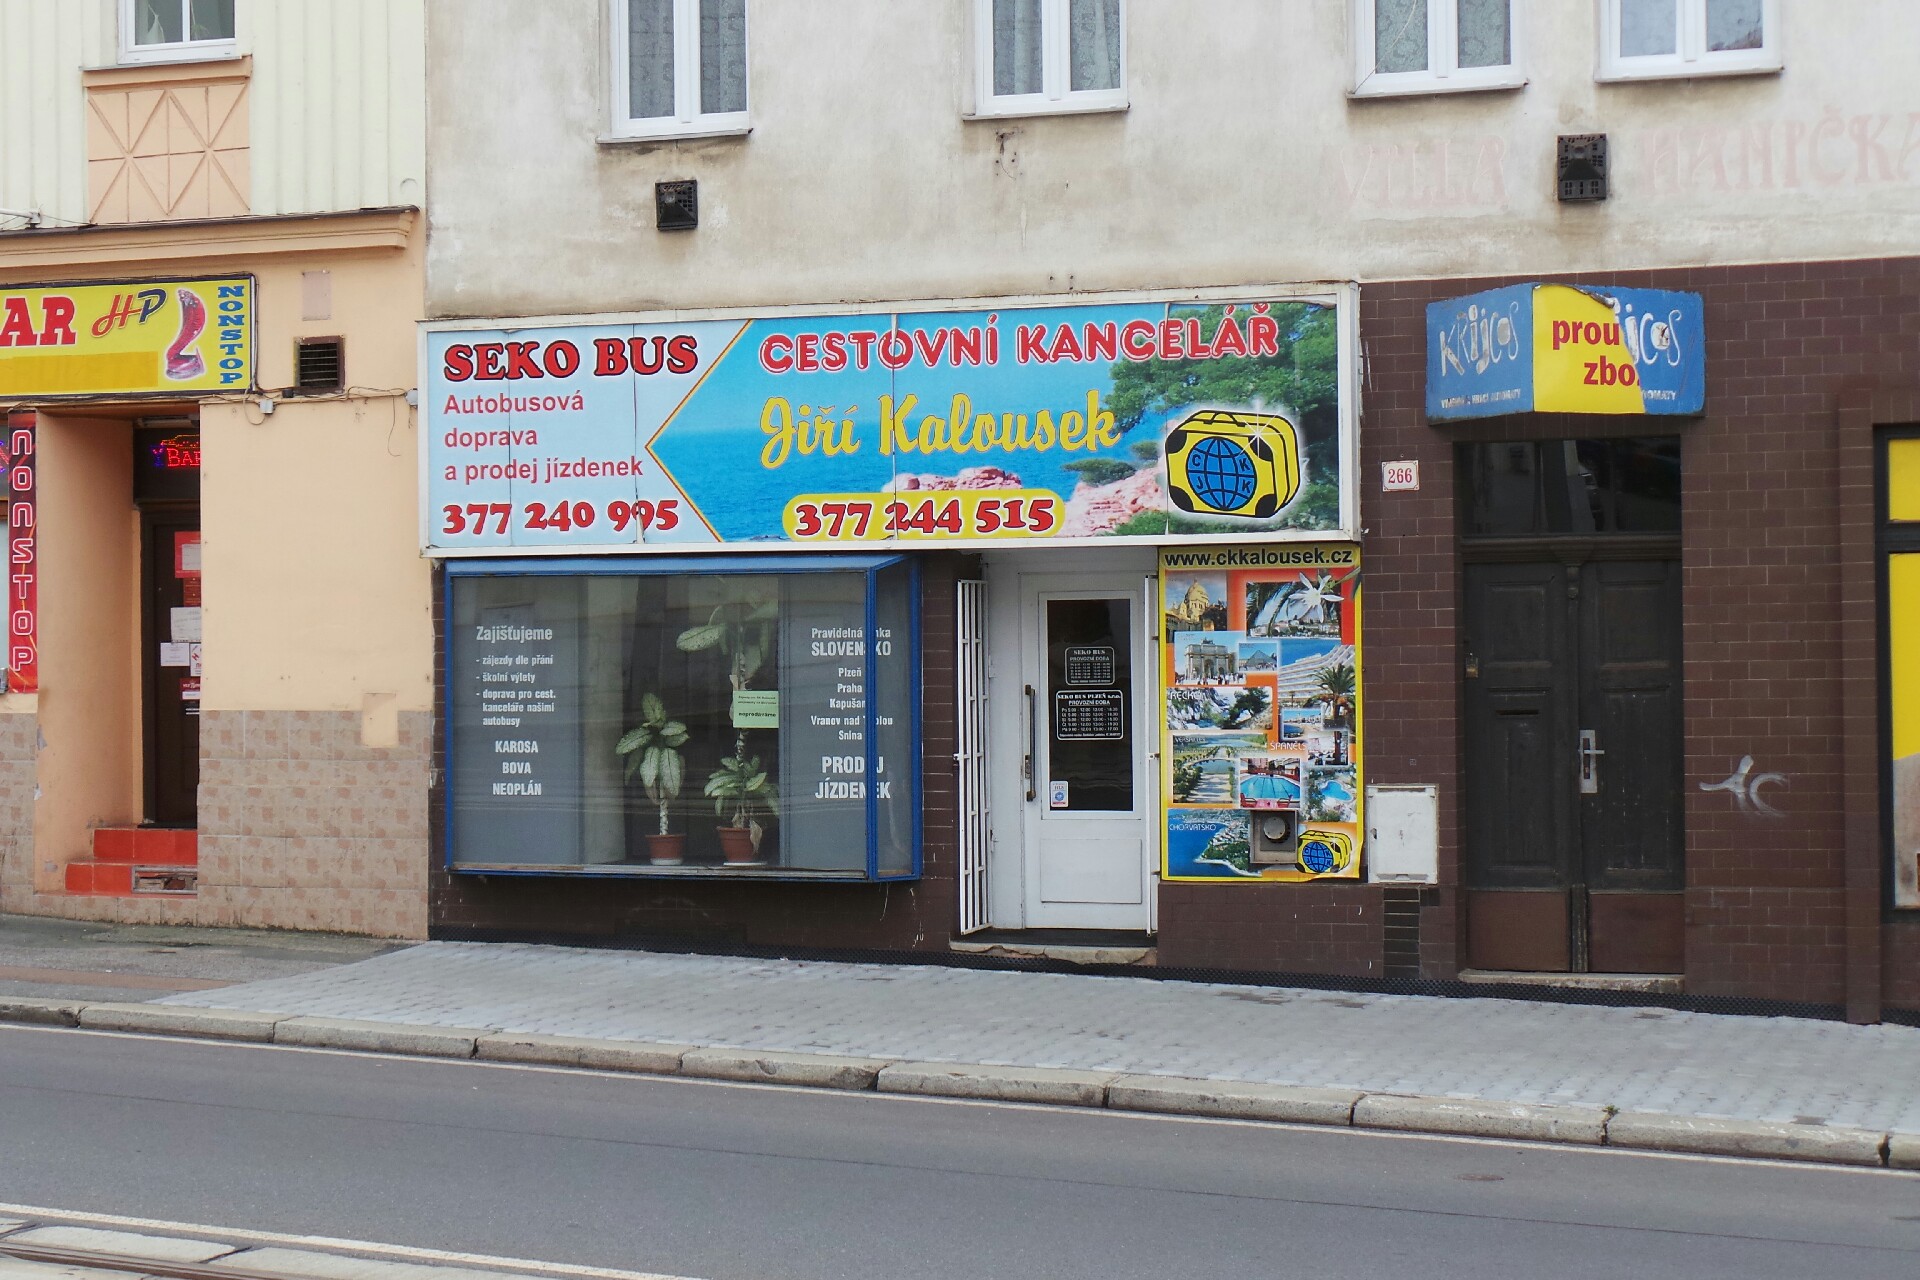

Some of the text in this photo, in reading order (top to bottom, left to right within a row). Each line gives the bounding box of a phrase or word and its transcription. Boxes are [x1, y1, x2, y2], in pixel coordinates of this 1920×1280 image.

[218, 285, 245, 384] NONSTOP
[759, 303, 1280, 373] CESTOVNÍ KANCELÁŘ
[443, 335, 698, 382] SEKO BUS
[443, 390, 584, 415] Autobusová
[759, 389, 1121, 469] Jiří Kalousek
[444, 428, 538, 451] doprava
[444, 455, 644, 485] a prodej jízdenek
[1388, 468, 1412, 485] 266
[442, 499, 679, 535] 377 240 995
[795, 498, 1055, 537] 377 244 515
[1165, 548, 1352, 566] www.ckkalousek.cz
[476, 625, 553, 644] Zajišťujeme
[811, 627, 863, 639] Pravidelná
[811, 641, 892, 656] SLOVENKO
[482, 655, 513, 667] zájezdy
[515, 655, 529, 665] dle
[531, 654, 554, 667] přání
[482, 672, 508, 682] školní
[510, 672, 536, 684] výlety
[838, 667, 862, 677] Plzeň
[482, 688, 516, 700] doprava
[518, 690, 532, 700] pro
[535, 689, 556, 699] cest.
[837, 683, 863, 693] Praha
[482, 702, 555, 712] kanceláře našimi
[482, 716, 520, 727] autobusy
[810, 716, 840, 725] Vranov
[844, 716, 860, 725] nad
[495, 741, 538, 753] KAROSA
[502, 762, 531, 774] BOVA
[821, 756, 884, 774] PRODJ
[492, 780, 542, 796] NEOPLÁN
[815, 777, 891, 799] JÍZDENK
